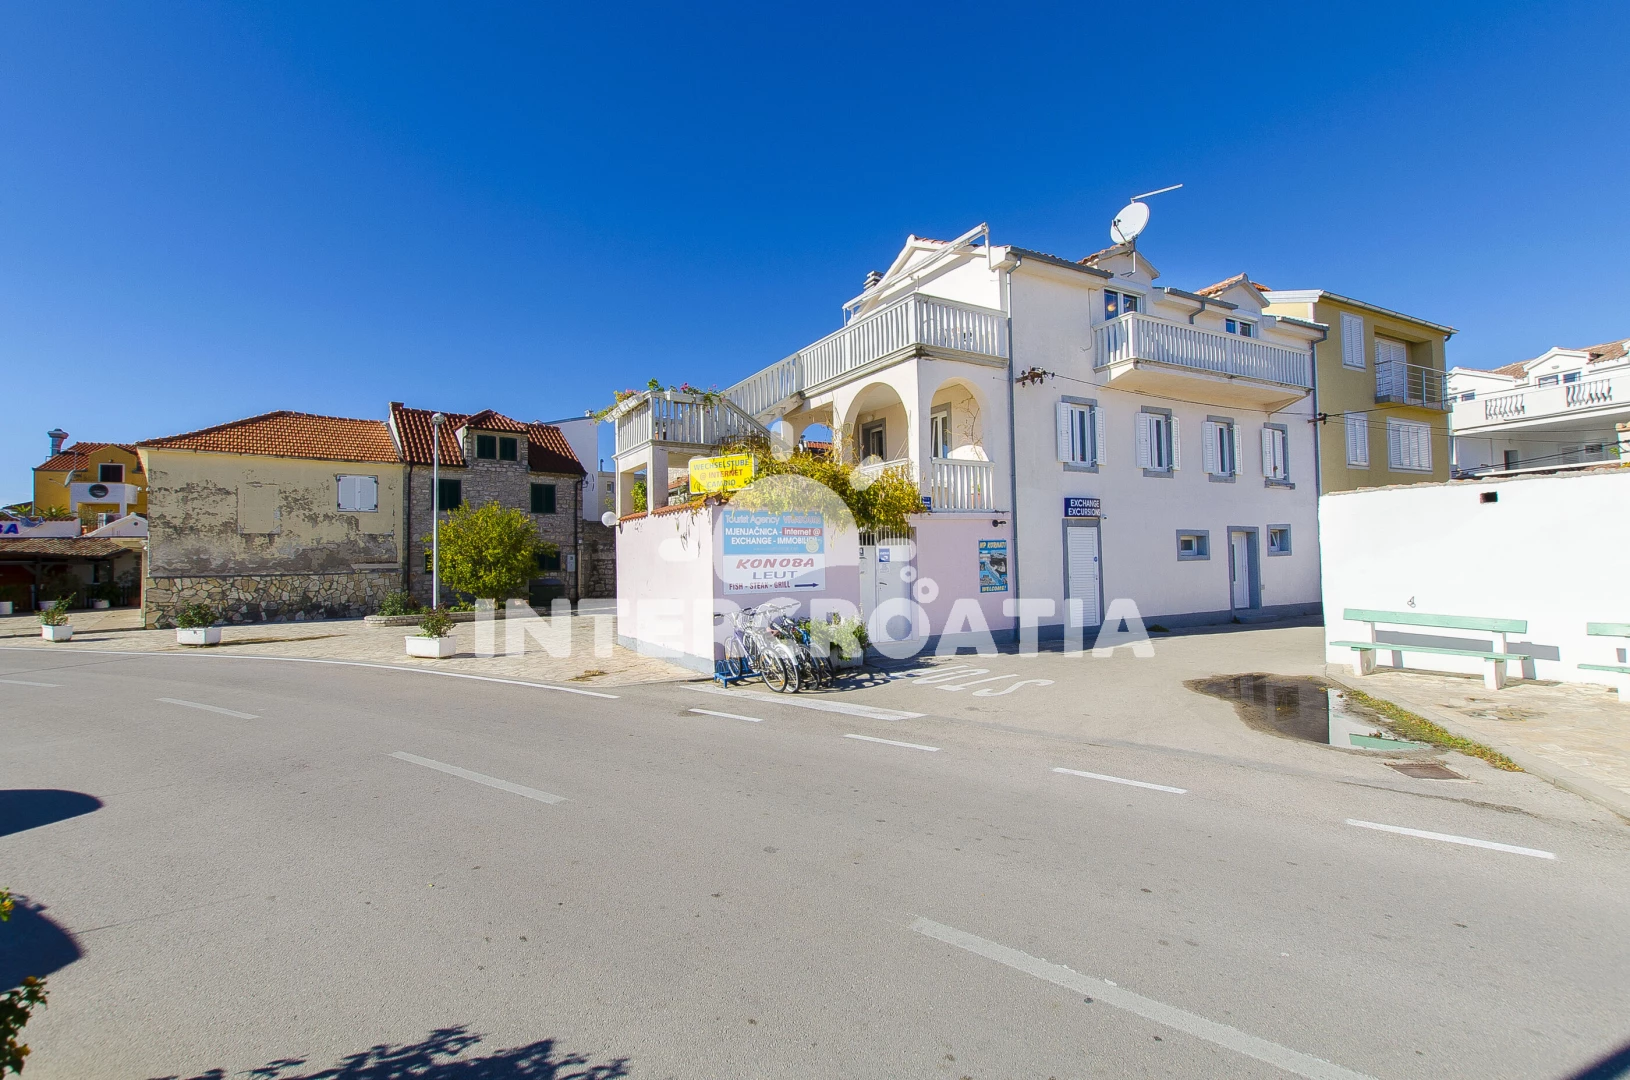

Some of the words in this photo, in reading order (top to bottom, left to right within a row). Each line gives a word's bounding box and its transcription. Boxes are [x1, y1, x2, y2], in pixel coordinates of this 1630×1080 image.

[694, 459, 749, 470] WECHSELSTUBE
[709, 468, 743, 479] INTERNET
[706, 479, 736, 488] CAMBIO
[1070, 499, 1100, 508] EXCHANGE
[725, 514, 749, 524] Tourist
[750, 515, 780, 526] Agency
[725, 526, 778, 536] MJENJAČNICA
[784, 528, 811, 536] internet
[731, 537, 772, 545] EXCHANGE
[736, 558, 814, 569] KONOBA
[752, 571, 798, 580] LEUT
[749, 581, 769, 590] STEAK
[774, 581, 791, 589] GRILL
